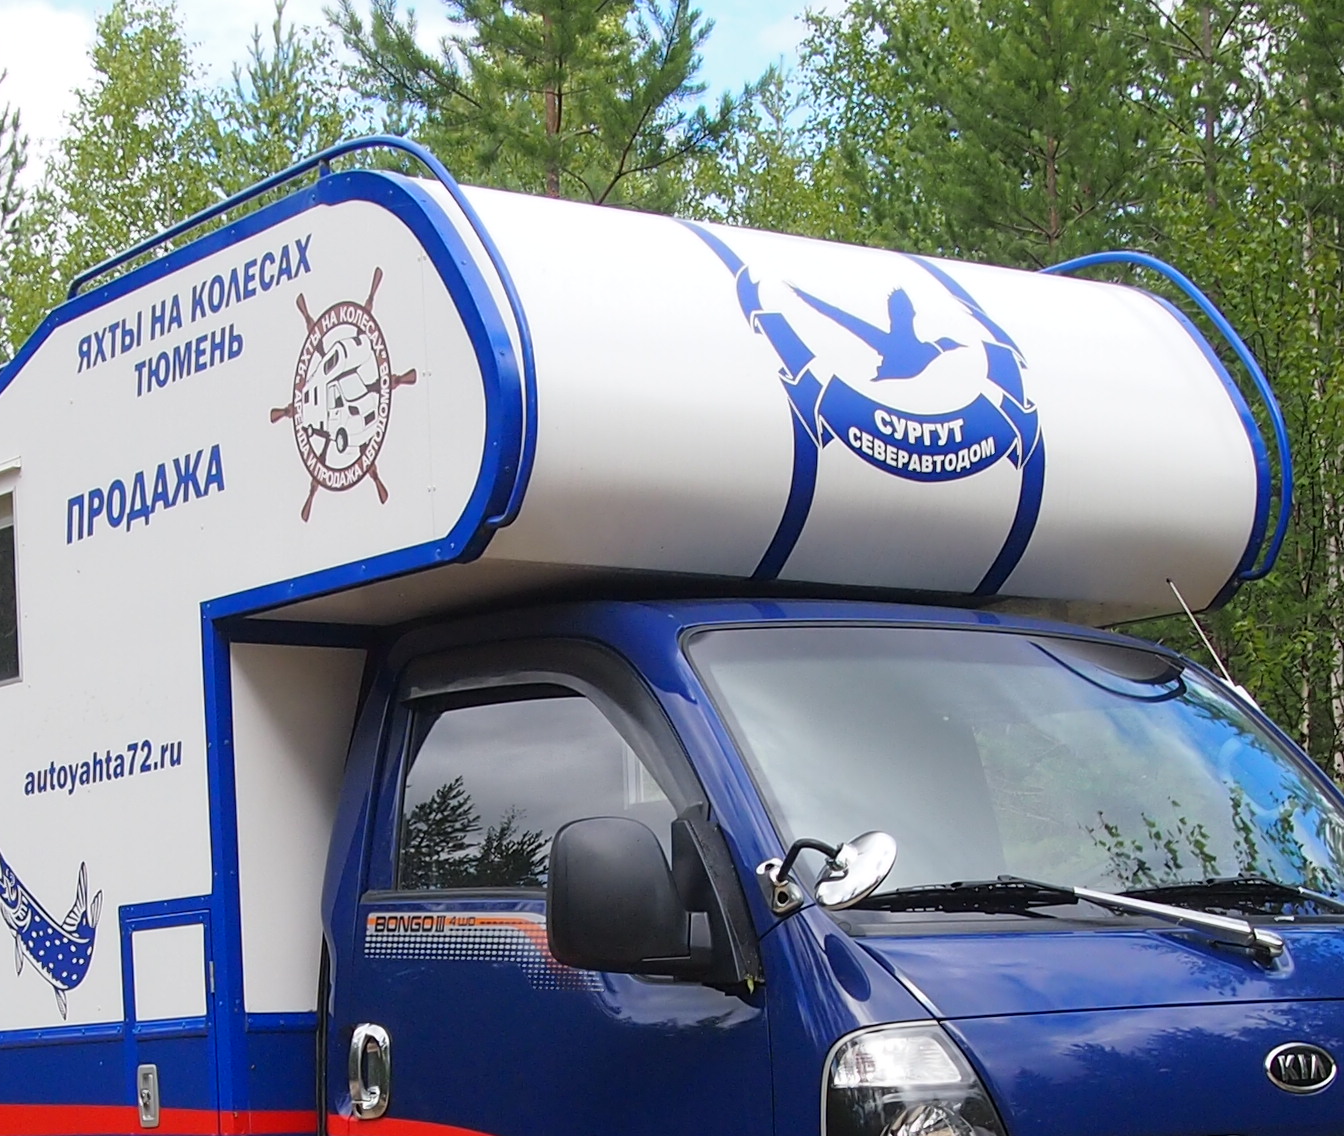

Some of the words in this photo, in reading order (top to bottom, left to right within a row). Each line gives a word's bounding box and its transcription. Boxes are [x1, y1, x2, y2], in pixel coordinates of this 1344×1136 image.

[77, 307, 142, 373] ЯХТЫ
[150, 293, 183, 337] НА
[191, 234, 312, 322] КОЛЕСАХ
[321, 310, 338, 332] НА
[134, 323, 245, 398] ТЮМЕНЬ
[294, 389, 310, 460] АРЕНДА
[306, 453, 318, 469] И
[314, 463, 362, 488] ПРОДАЖА
[361, 361, 390, 472] АВТОДОМОВ
[848, 426, 996, 474] СЕВЕРАВТОДОМ
[873, 408, 965, 447] СУРГУТ
[66, 443, 226, 545] ПРОДАЖА
[23, 737, 184, 798] autoyahta72.ru
[1277, 1053, 1327, 1082] KIA
